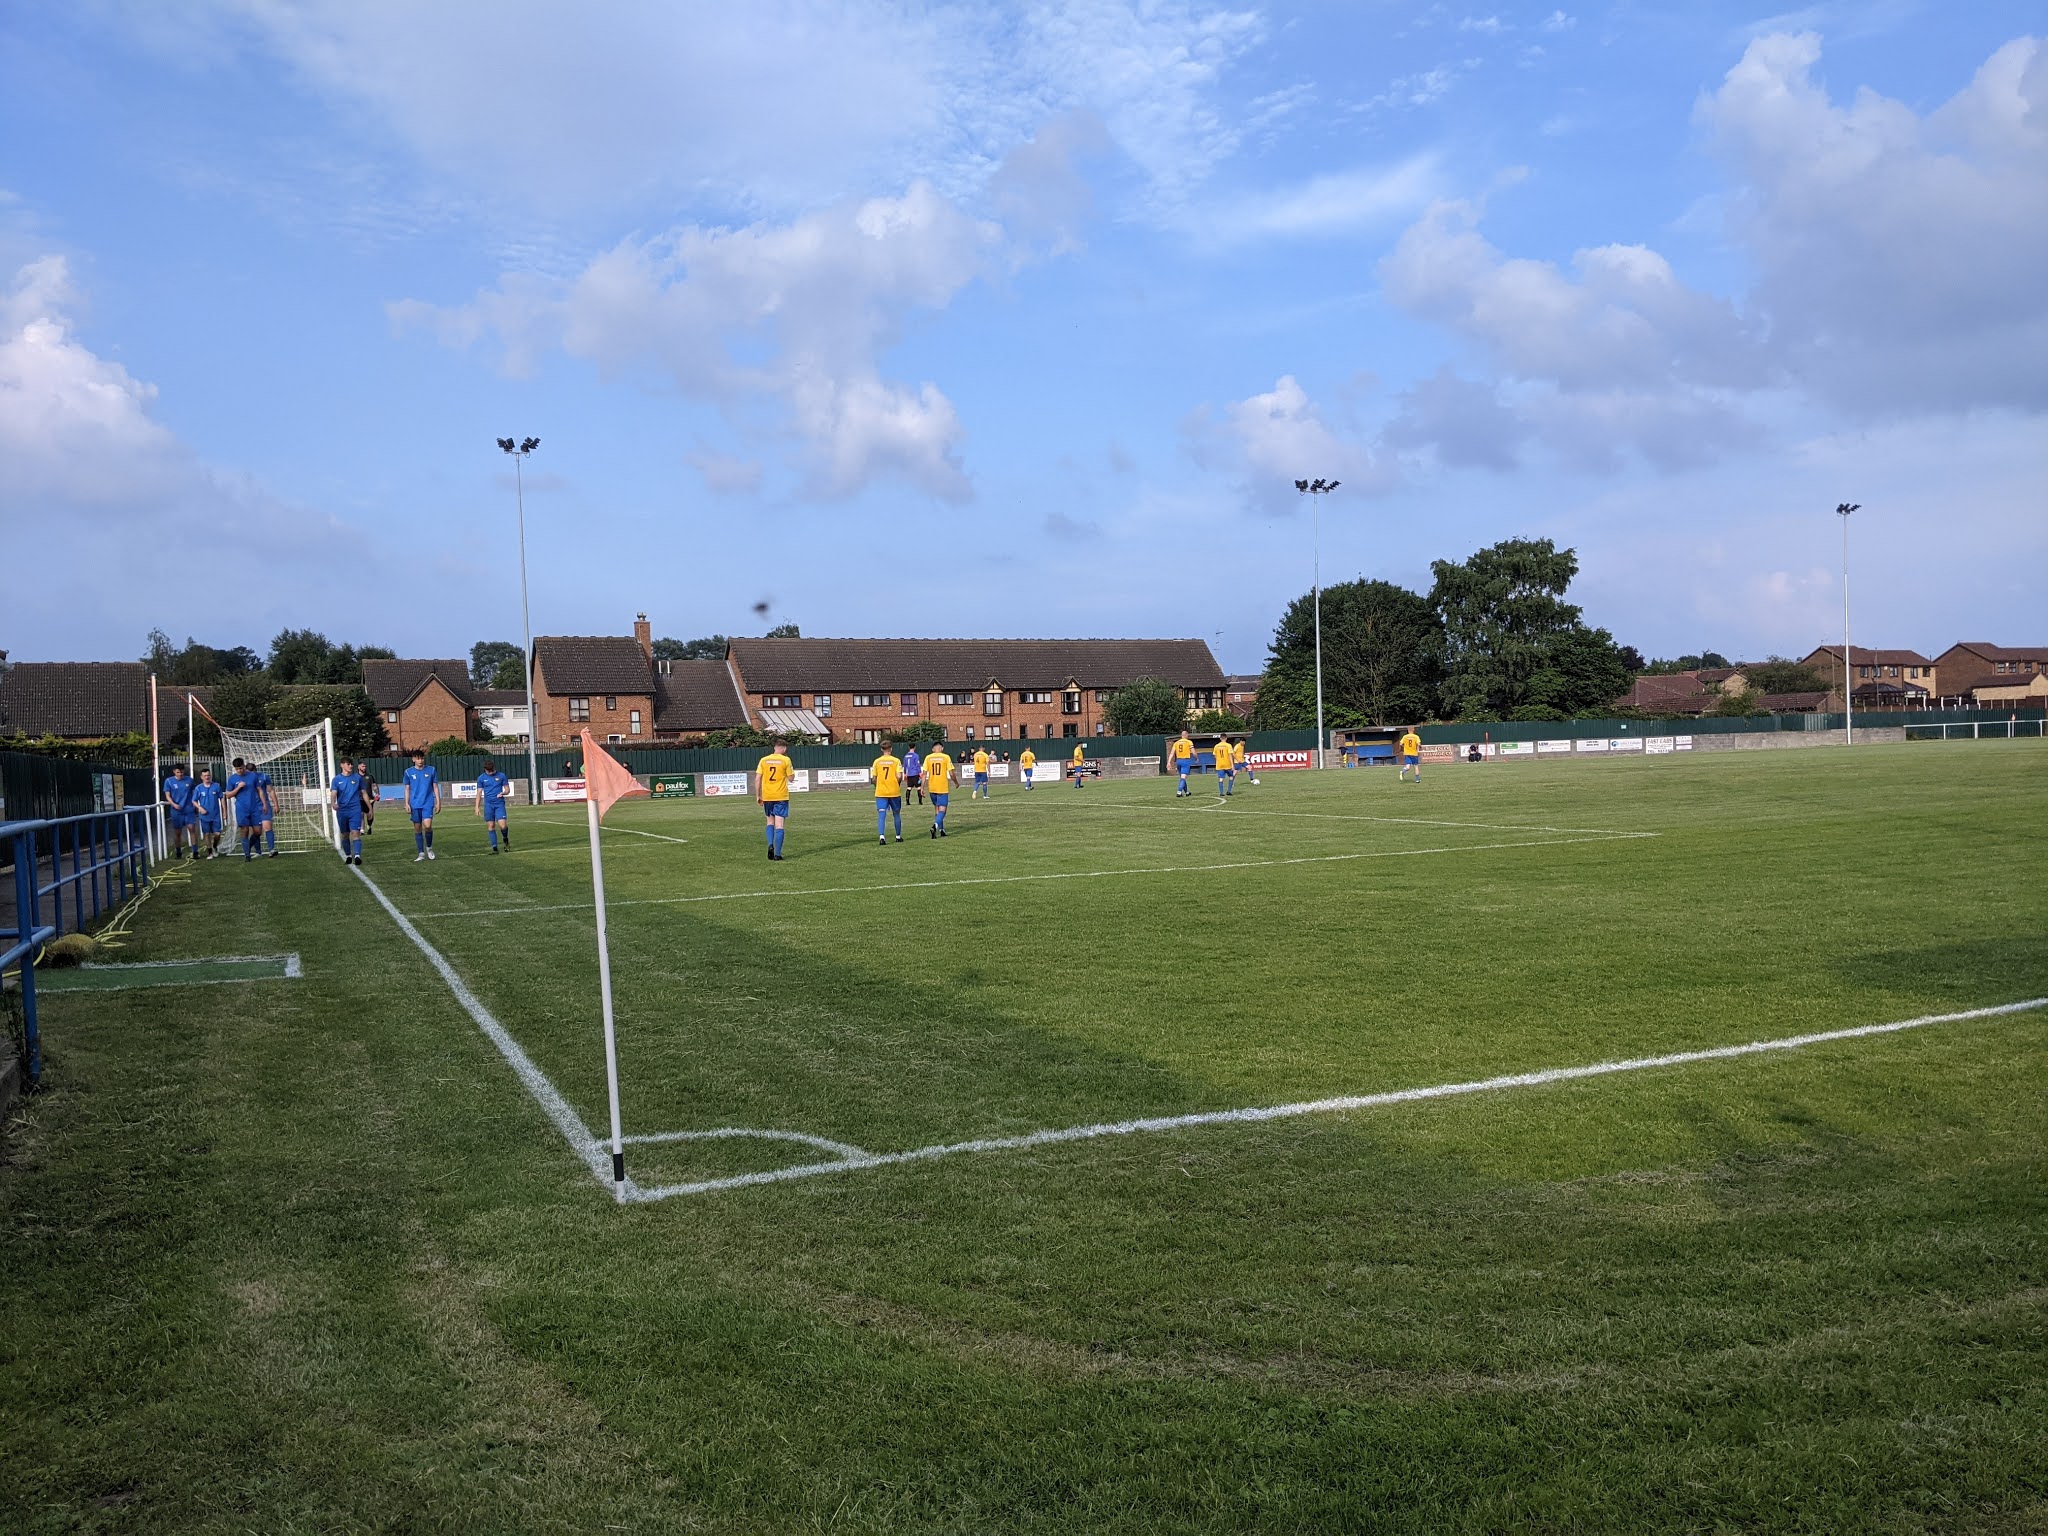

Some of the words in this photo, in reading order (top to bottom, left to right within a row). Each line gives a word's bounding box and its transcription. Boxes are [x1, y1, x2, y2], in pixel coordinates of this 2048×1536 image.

[1179, 744, 1184, 753] 9
[769, 766, 777, 782] 2
[882, 767, 889, 780] 7
[932, 763, 942, 776] 10
[665, 781, 679, 791] paul
[679, 781, 689, 789] fox
